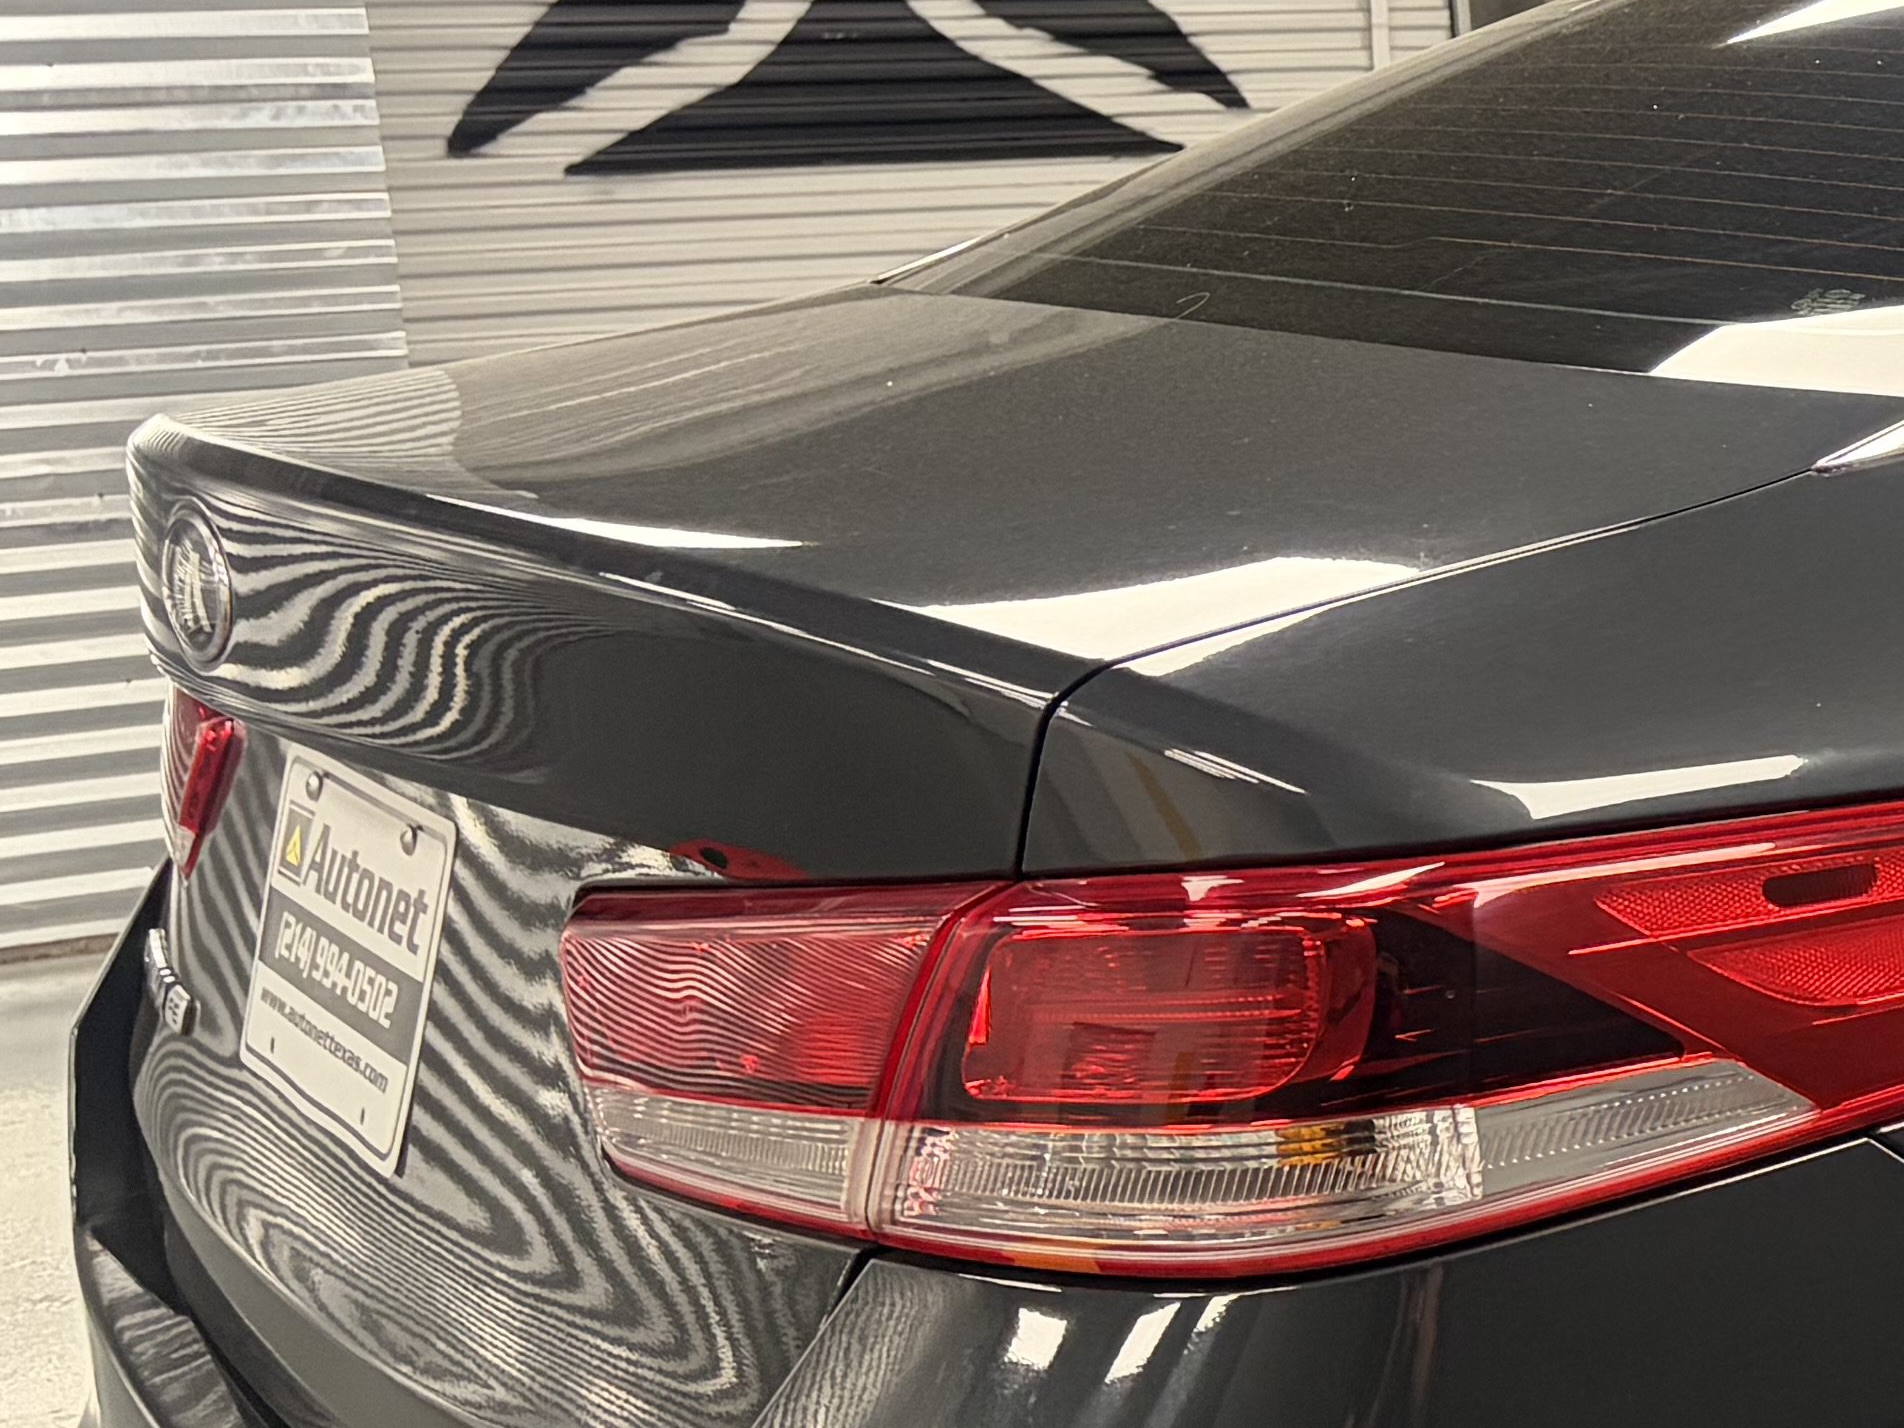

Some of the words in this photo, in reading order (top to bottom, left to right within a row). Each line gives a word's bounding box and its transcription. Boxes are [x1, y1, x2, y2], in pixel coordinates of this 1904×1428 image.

[302, 823, 428, 955] Autonet
[274, 911, 317, 979] (214)
[261, 986, 389, 1094] www.autonettexas.com
